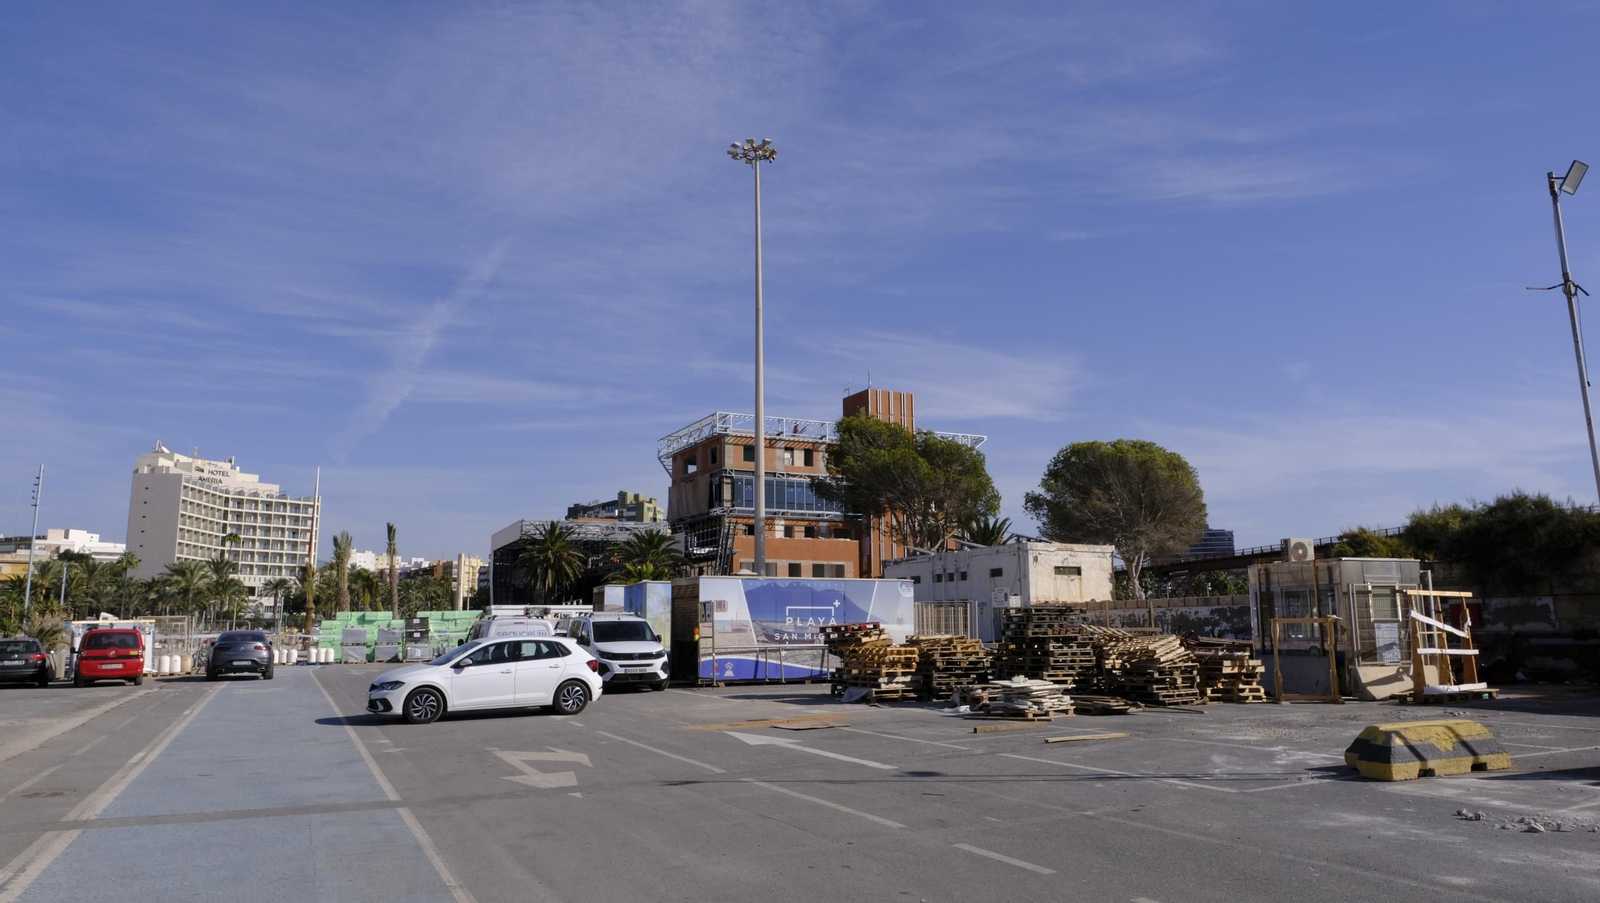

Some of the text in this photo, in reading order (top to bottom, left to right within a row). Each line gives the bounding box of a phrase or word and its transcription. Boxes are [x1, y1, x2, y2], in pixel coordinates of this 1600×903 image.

[208, 469, 230, 477] HOTEL
[786, 617, 837, 626] PLAYA
[775, 633, 825, 641] SAN MIG
